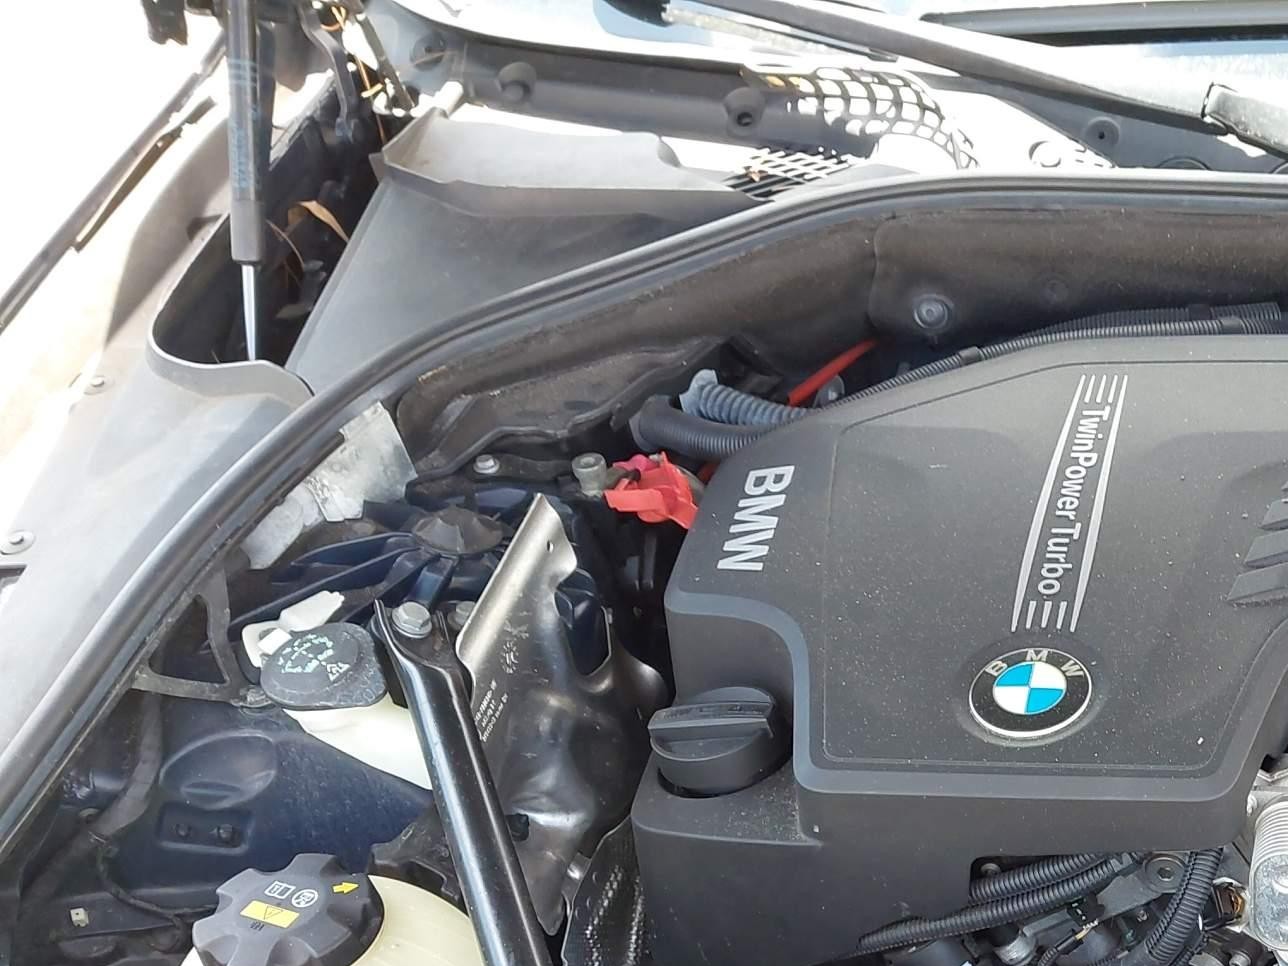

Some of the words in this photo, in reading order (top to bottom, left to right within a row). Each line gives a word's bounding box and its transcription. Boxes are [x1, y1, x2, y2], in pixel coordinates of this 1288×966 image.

[1055, 405, 1111, 520] TwinPower
[717, 465, 795, 571] BMW
[1037, 522, 1082, 595] Turbo
[984, 648, 1085, 678] BMW
